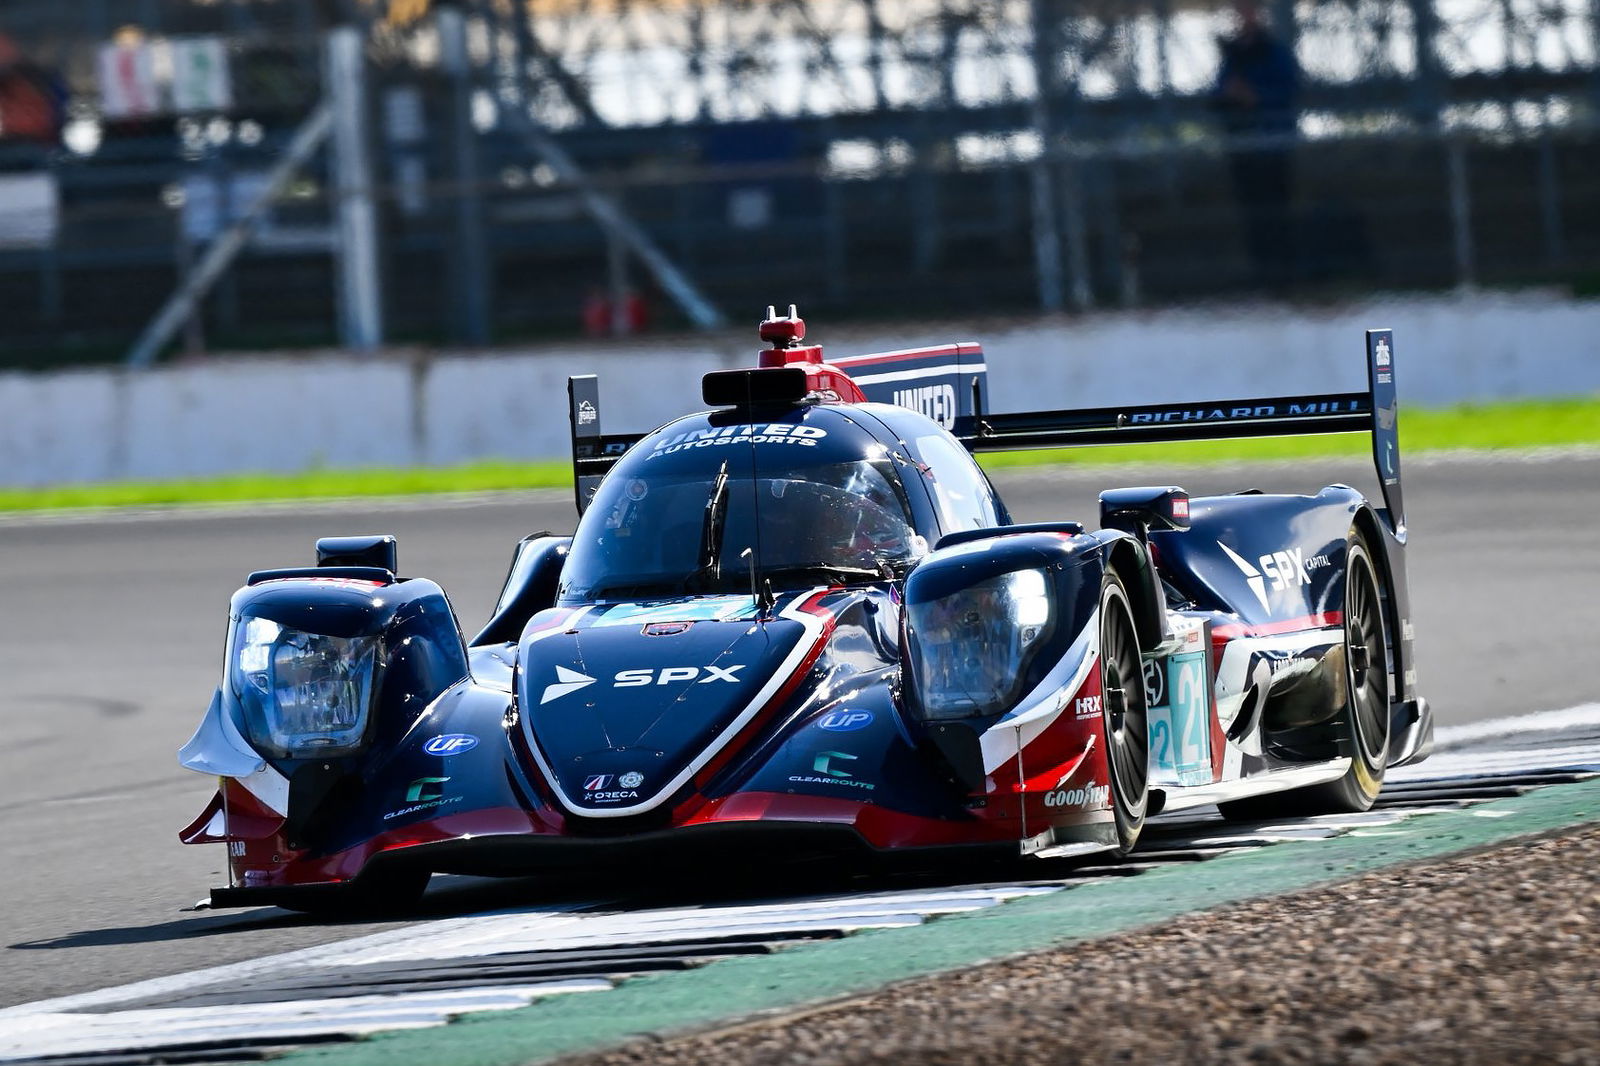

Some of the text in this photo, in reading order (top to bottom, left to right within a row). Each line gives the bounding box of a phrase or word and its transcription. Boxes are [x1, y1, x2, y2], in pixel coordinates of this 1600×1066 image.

[1131, 400, 1366, 423] RICHARD MILL
[645, 435, 819, 461] AUTOSPORTS
[654, 423, 828, 450] UNITED
[1259, 547, 1331, 591] SPX CAPITAL
[613, 664, 747, 688] SPX
[1075, 695, 1102, 715] HRX
[823, 713, 870, 728] UP
[427, 738, 475, 752] UP
[788, 775, 876, 790] CLEARROUTE
[594, 791, 638, 799] ORECA
[383, 796, 464, 820] CLEARROUTE
